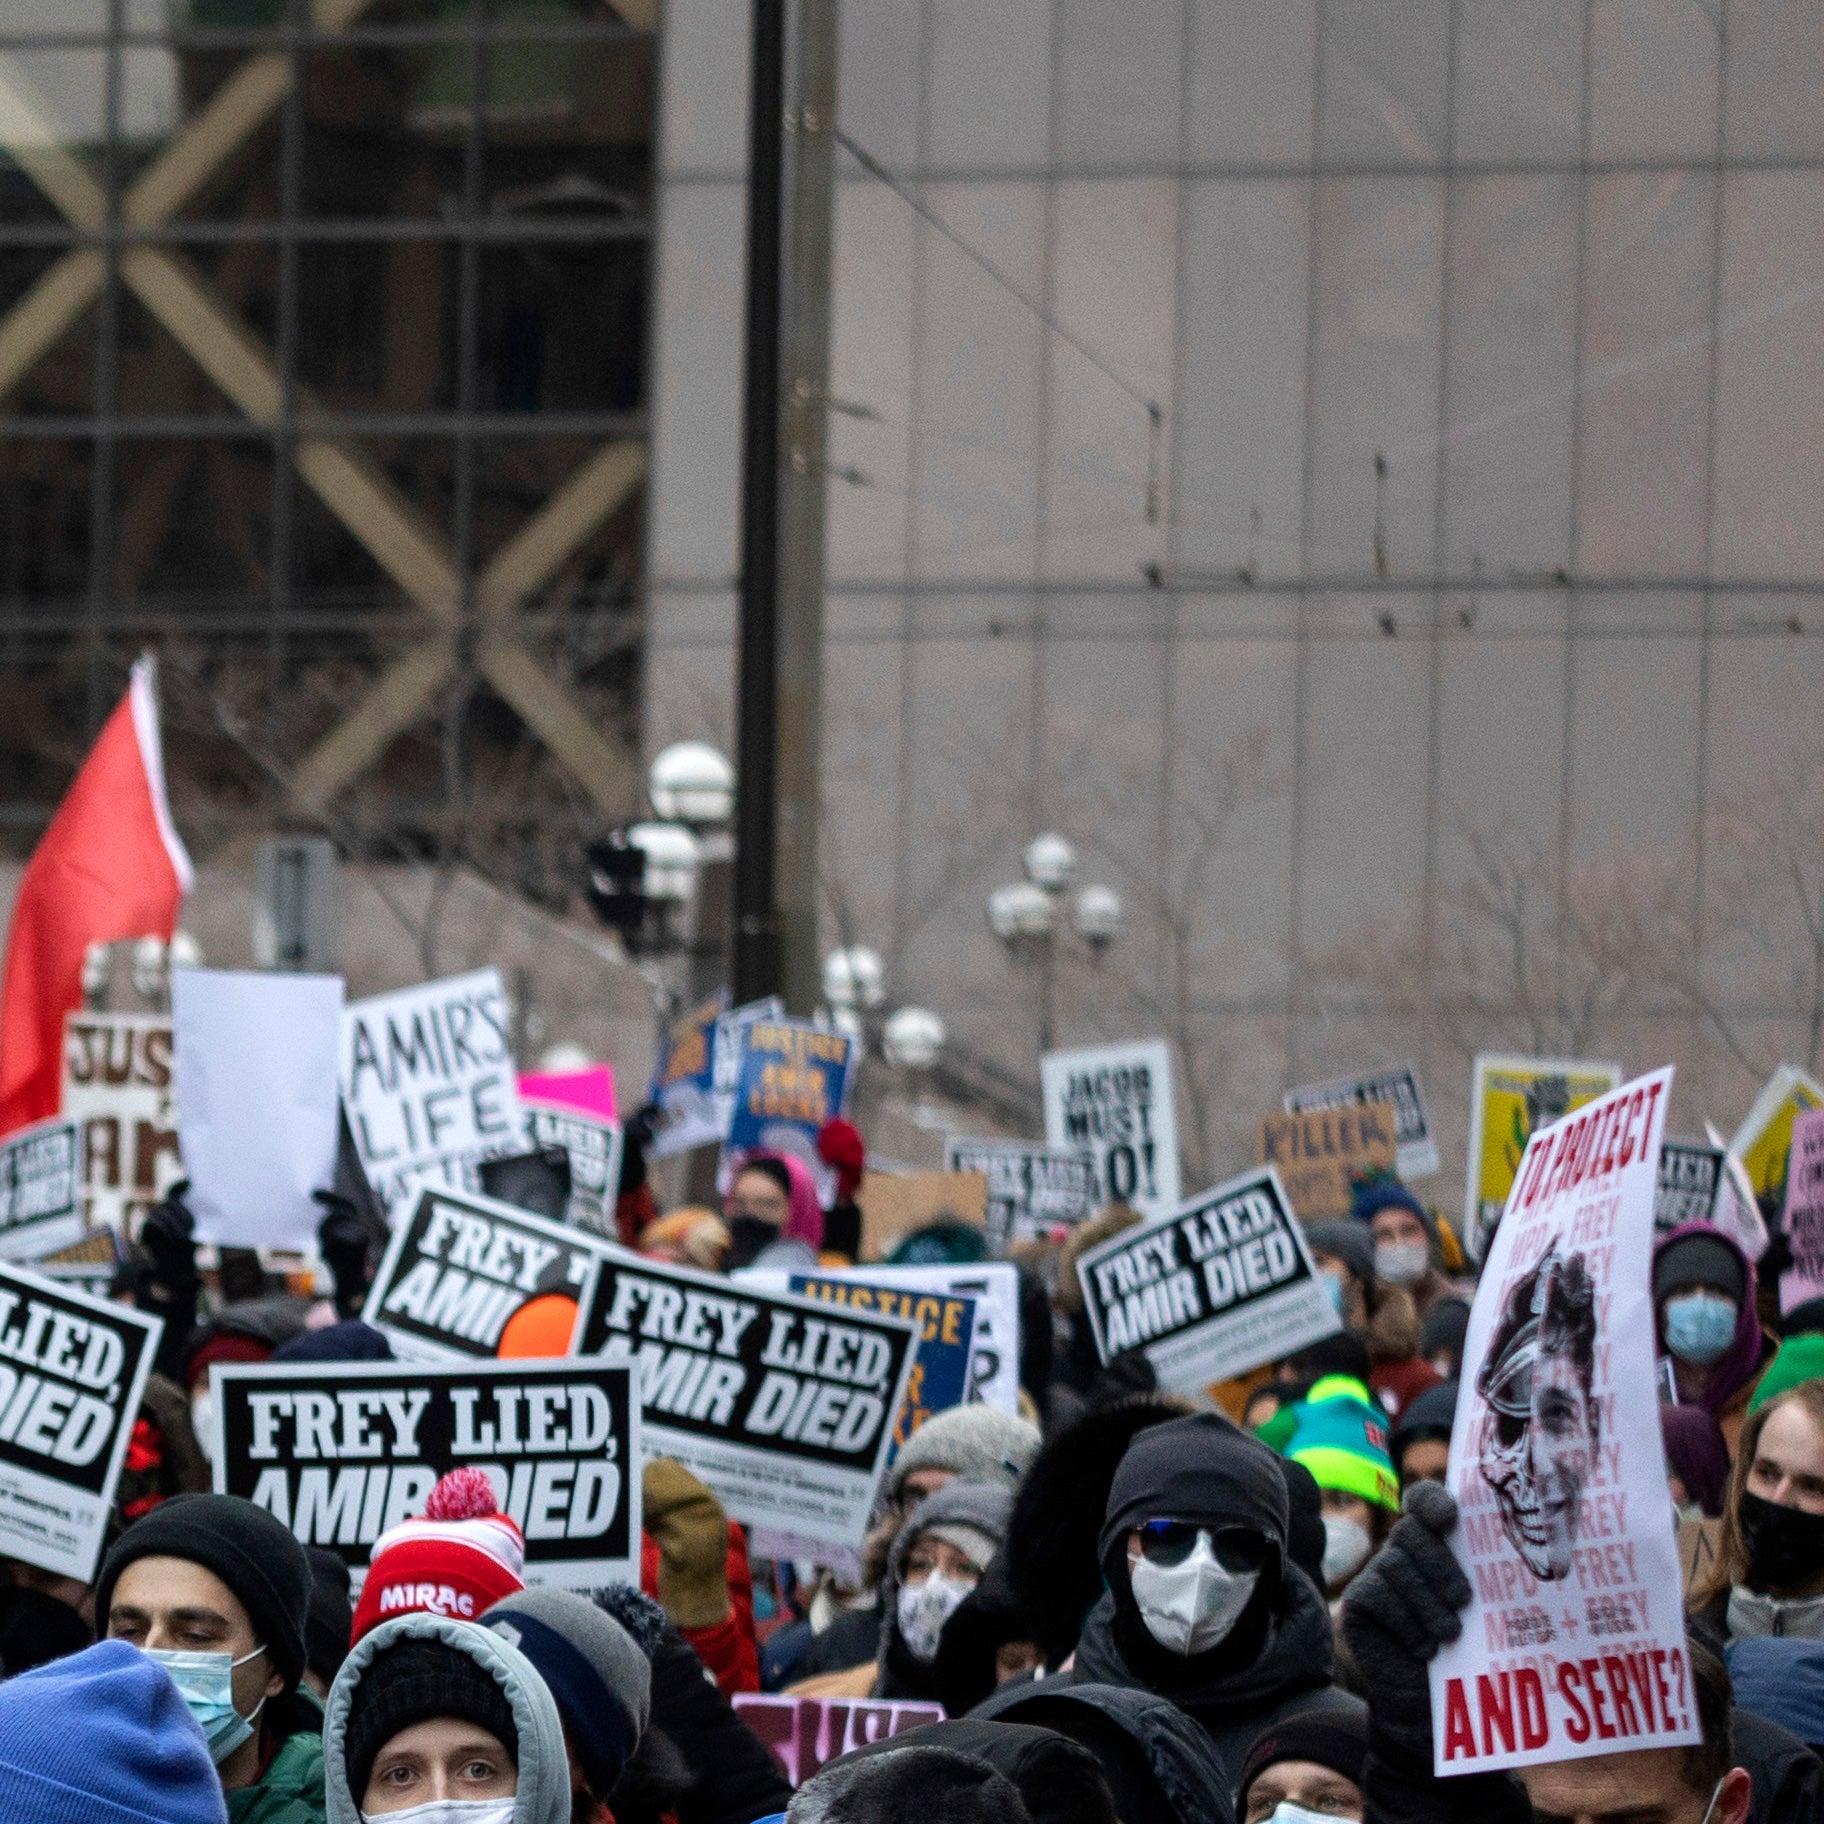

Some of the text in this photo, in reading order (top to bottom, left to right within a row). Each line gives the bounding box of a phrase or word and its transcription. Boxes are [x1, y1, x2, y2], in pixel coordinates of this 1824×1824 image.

[357, 1073, 510, 1162] LIFE
[1542, 1080, 1664, 1200] PROTECT
[416, 1201, 559, 1292] FREY
[1094, 1226, 1178, 1302] FREY
[605, 1272, 759, 1358] FREY
[760, 1312, 894, 1398] LIED,
[1106, 1265, 1202, 1356] AMIR
[1202, 1228, 1299, 1310] DIED
[247, 1384, 617, 1460] FREY LIED,
[744, 1370, 887, 1455] DIED
[1572, 1541, 1640, 1591] FREY
[1443, 1646, 1690, 1762] AND SERVE?
